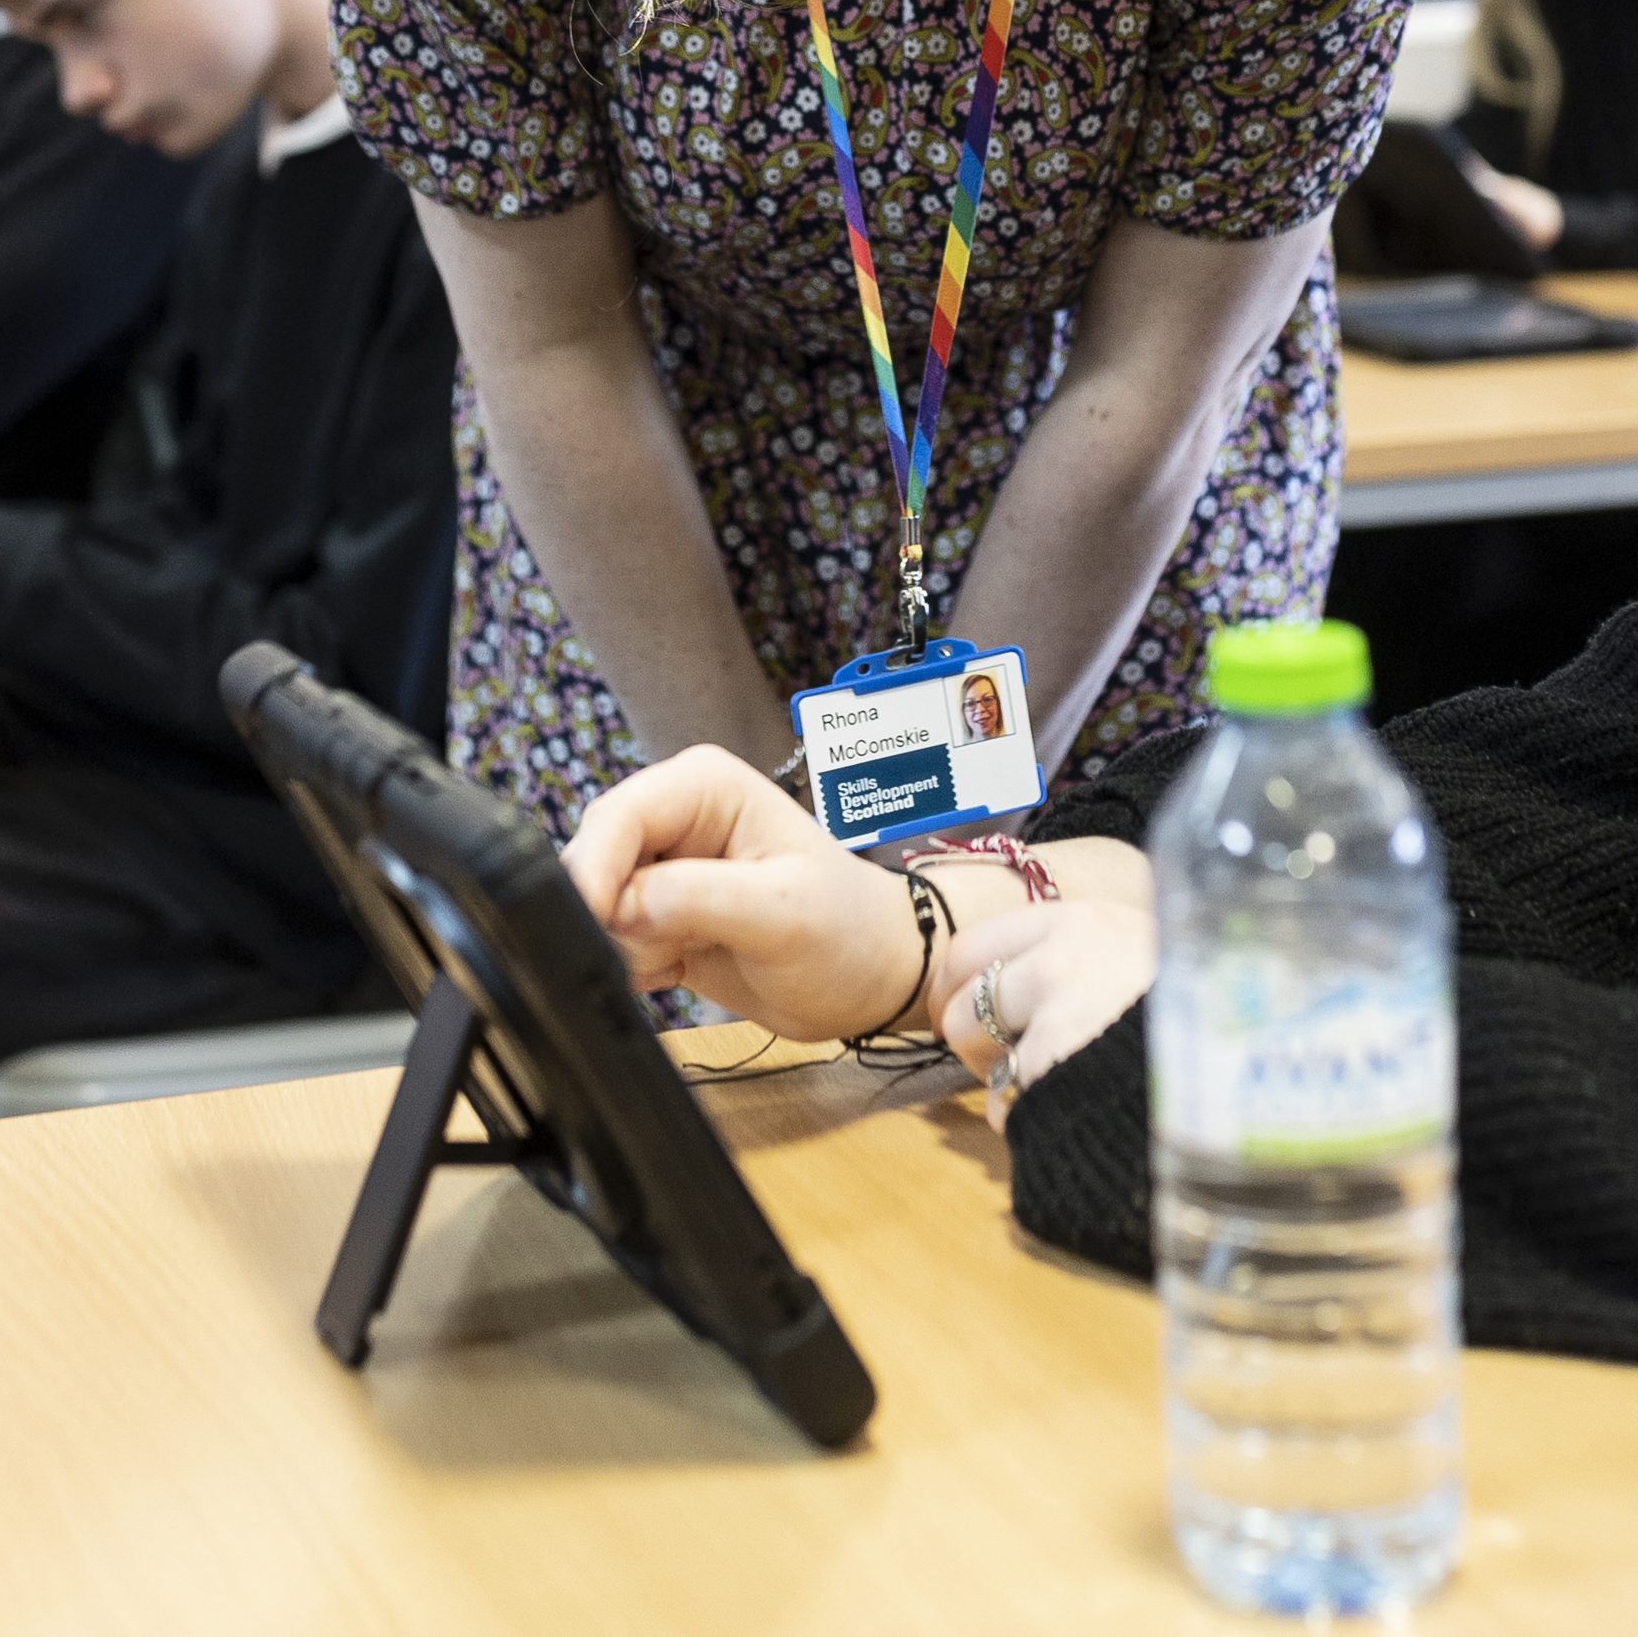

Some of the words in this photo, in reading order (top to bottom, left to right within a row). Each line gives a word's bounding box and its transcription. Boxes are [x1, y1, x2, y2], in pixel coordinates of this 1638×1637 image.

[821, 707, 879, 732] Rhona
[829, 727, 930, 763] McComskie
[837, 777, 878, 797] Skills
[840, 775, 940, 810] Development
[842, 794, 915, 824] Scotland
